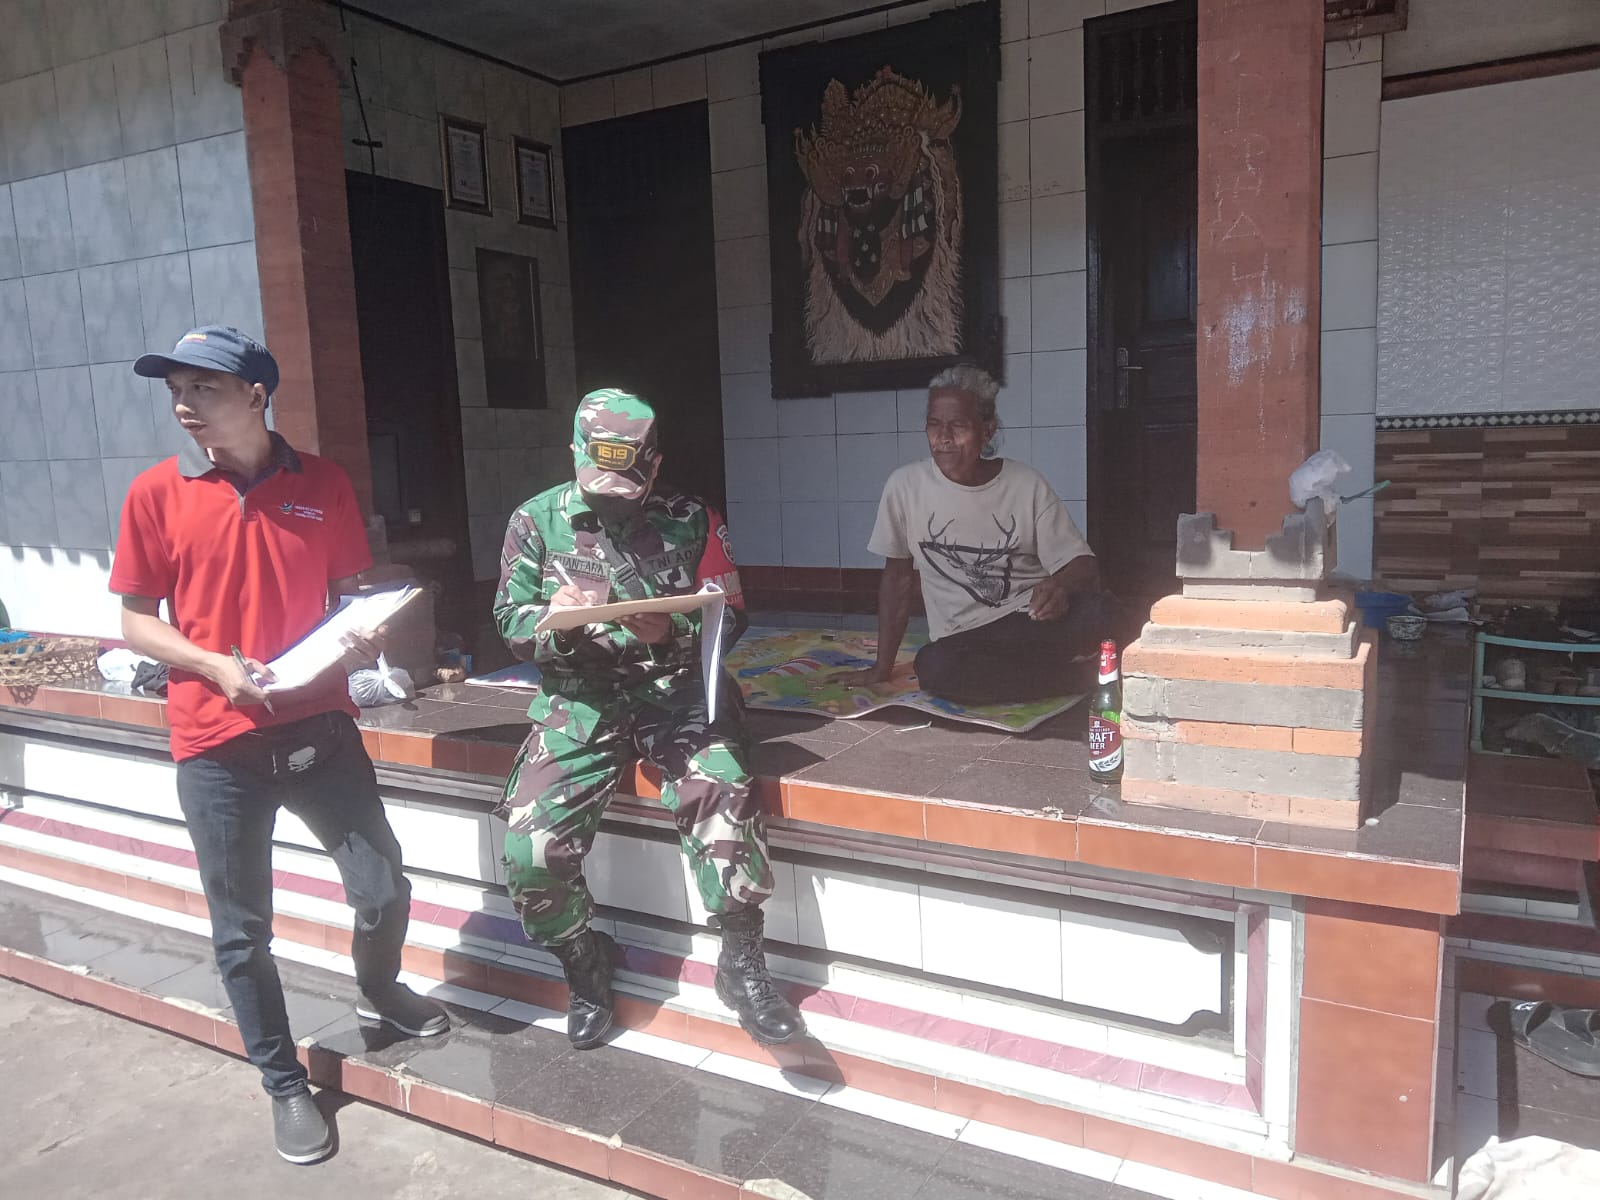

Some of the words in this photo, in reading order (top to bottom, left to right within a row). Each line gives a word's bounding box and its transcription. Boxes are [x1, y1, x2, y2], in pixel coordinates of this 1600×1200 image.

[597, 445, 628, 460] 1619
[647, 554, 671, 570] TNI
[1088, 730, 1116, 743] RAFT
